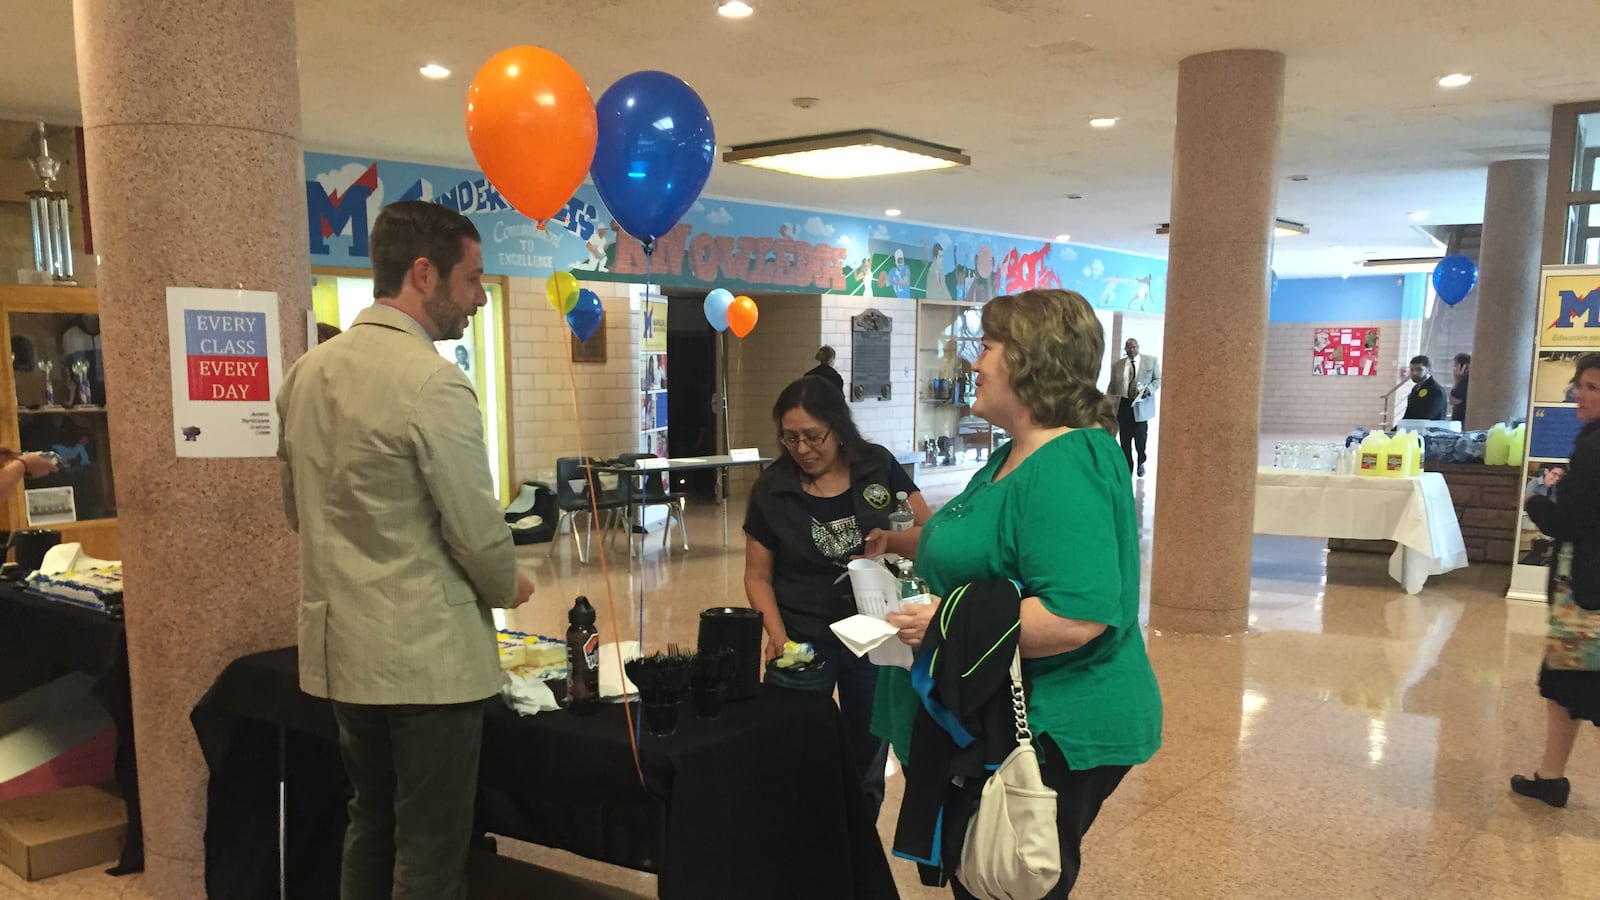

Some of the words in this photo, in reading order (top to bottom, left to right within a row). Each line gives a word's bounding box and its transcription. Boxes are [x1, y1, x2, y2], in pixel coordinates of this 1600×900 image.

[306, 180, 373, 257] M
[519, 239, 535, 253] TO
[499, 253, 553, 268] EXCELLENCE
[1555, 290, 1600, 328] M
[196, 315, 257, 333] EVERY
[200, 338, 256, 356] CLASS
[199, 360, 259, 377] EVERY
[211, 383, 250, 400] DAY
